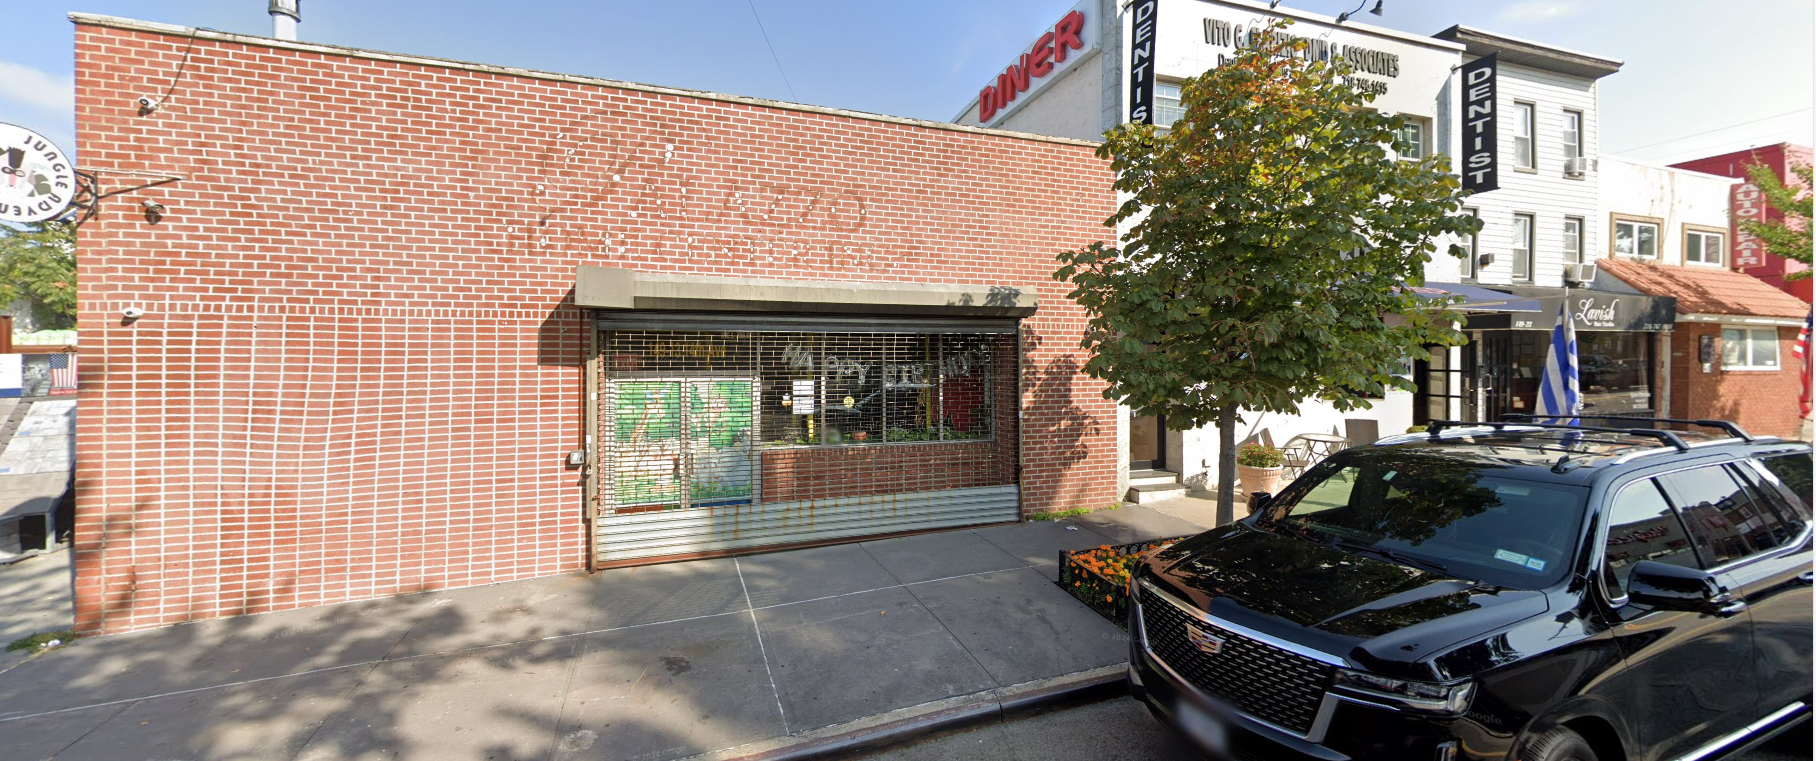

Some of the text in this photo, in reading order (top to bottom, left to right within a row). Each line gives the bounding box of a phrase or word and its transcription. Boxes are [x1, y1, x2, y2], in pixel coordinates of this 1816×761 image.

[979, 9, 1084, 123] DINER
[1132, 1, 1155, 125] DENTIS
[1203, 17, 1232, 47] VITO
[1342, 44, 1399, 78] ASSOCIATES
[1468, 67, 1492, 184] DENTIST
[1736, 184, 1760, 217] AUTO
[1575, 298, 1620, 325] Lavish
[648, 342, 681, 358] 149-13
[708, 343, 727, 358] Ave
